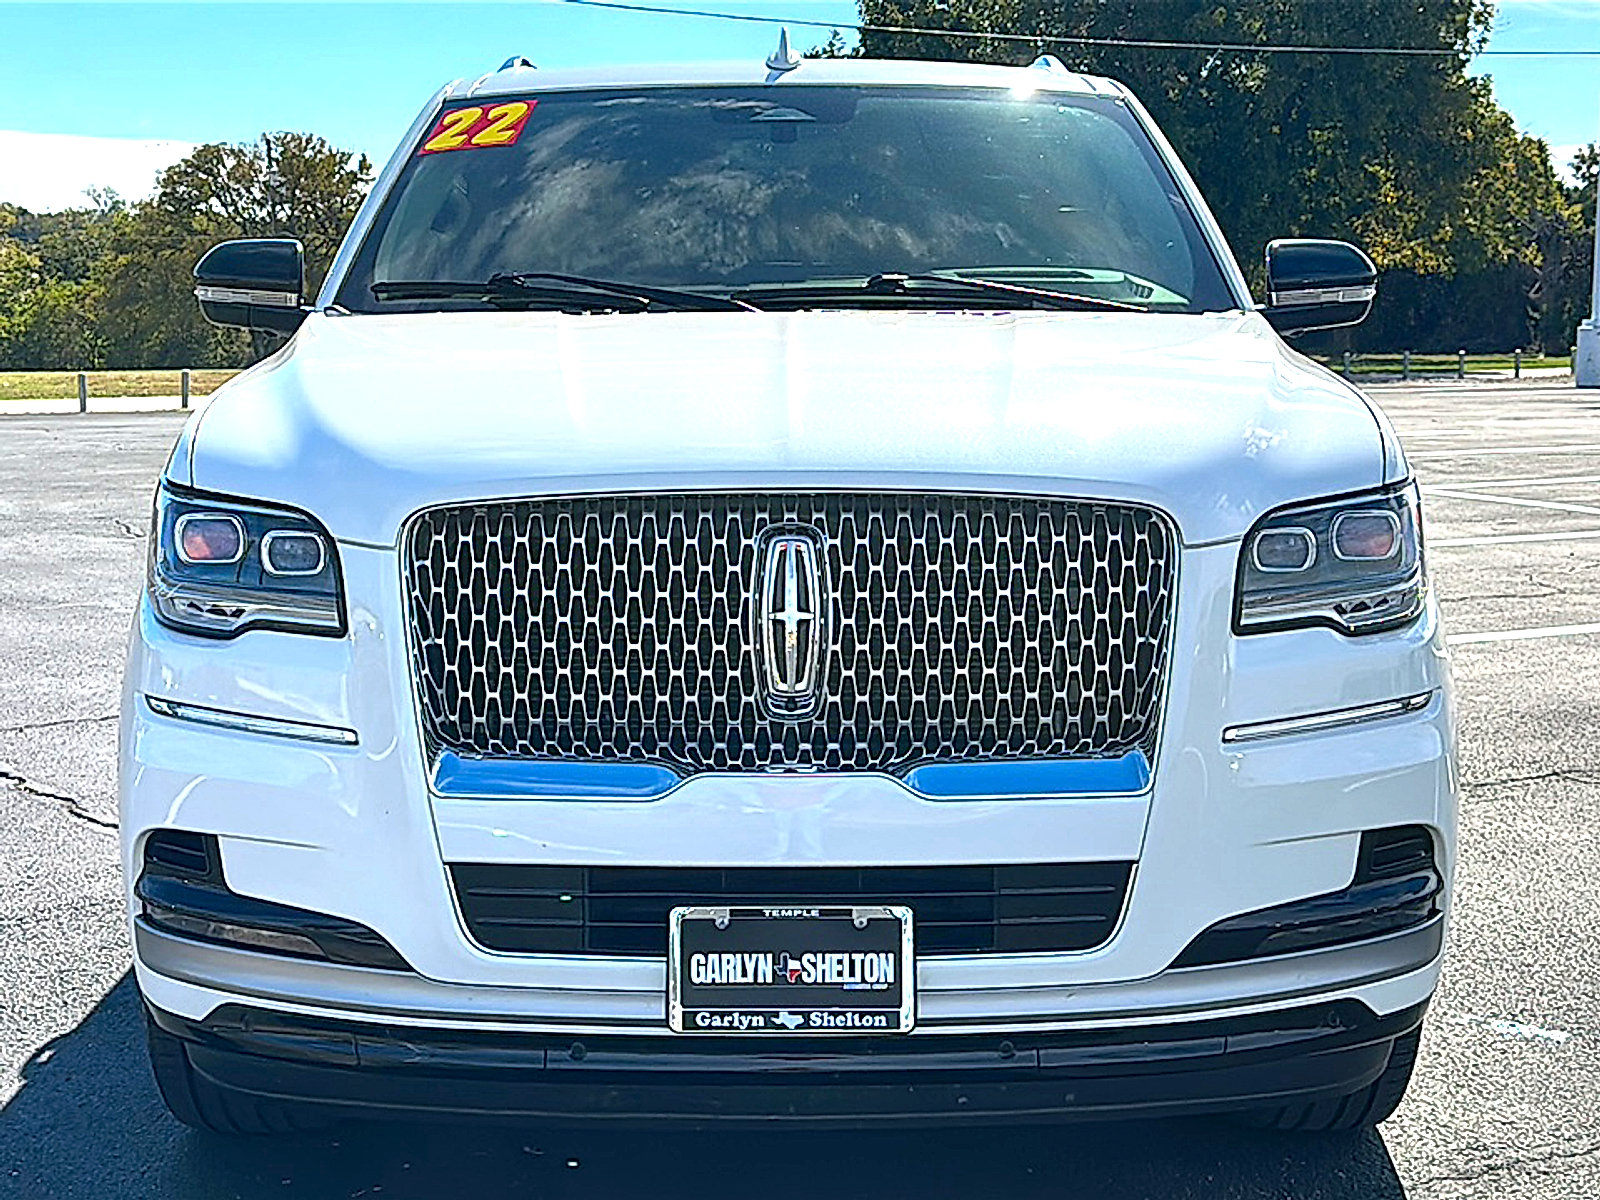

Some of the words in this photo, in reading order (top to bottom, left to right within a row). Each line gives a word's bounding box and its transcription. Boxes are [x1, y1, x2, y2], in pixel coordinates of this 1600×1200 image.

[424, 103, 529, 151] 22
[762, 909, 820, 917] TEMPLE
[690, 953, 773, 984] GARLYN
[801, 953, 895, 984] SHELTON
[695, 1012, 765, 1029] Garlyn
[809, 1012, 887, 1026] Shelton
